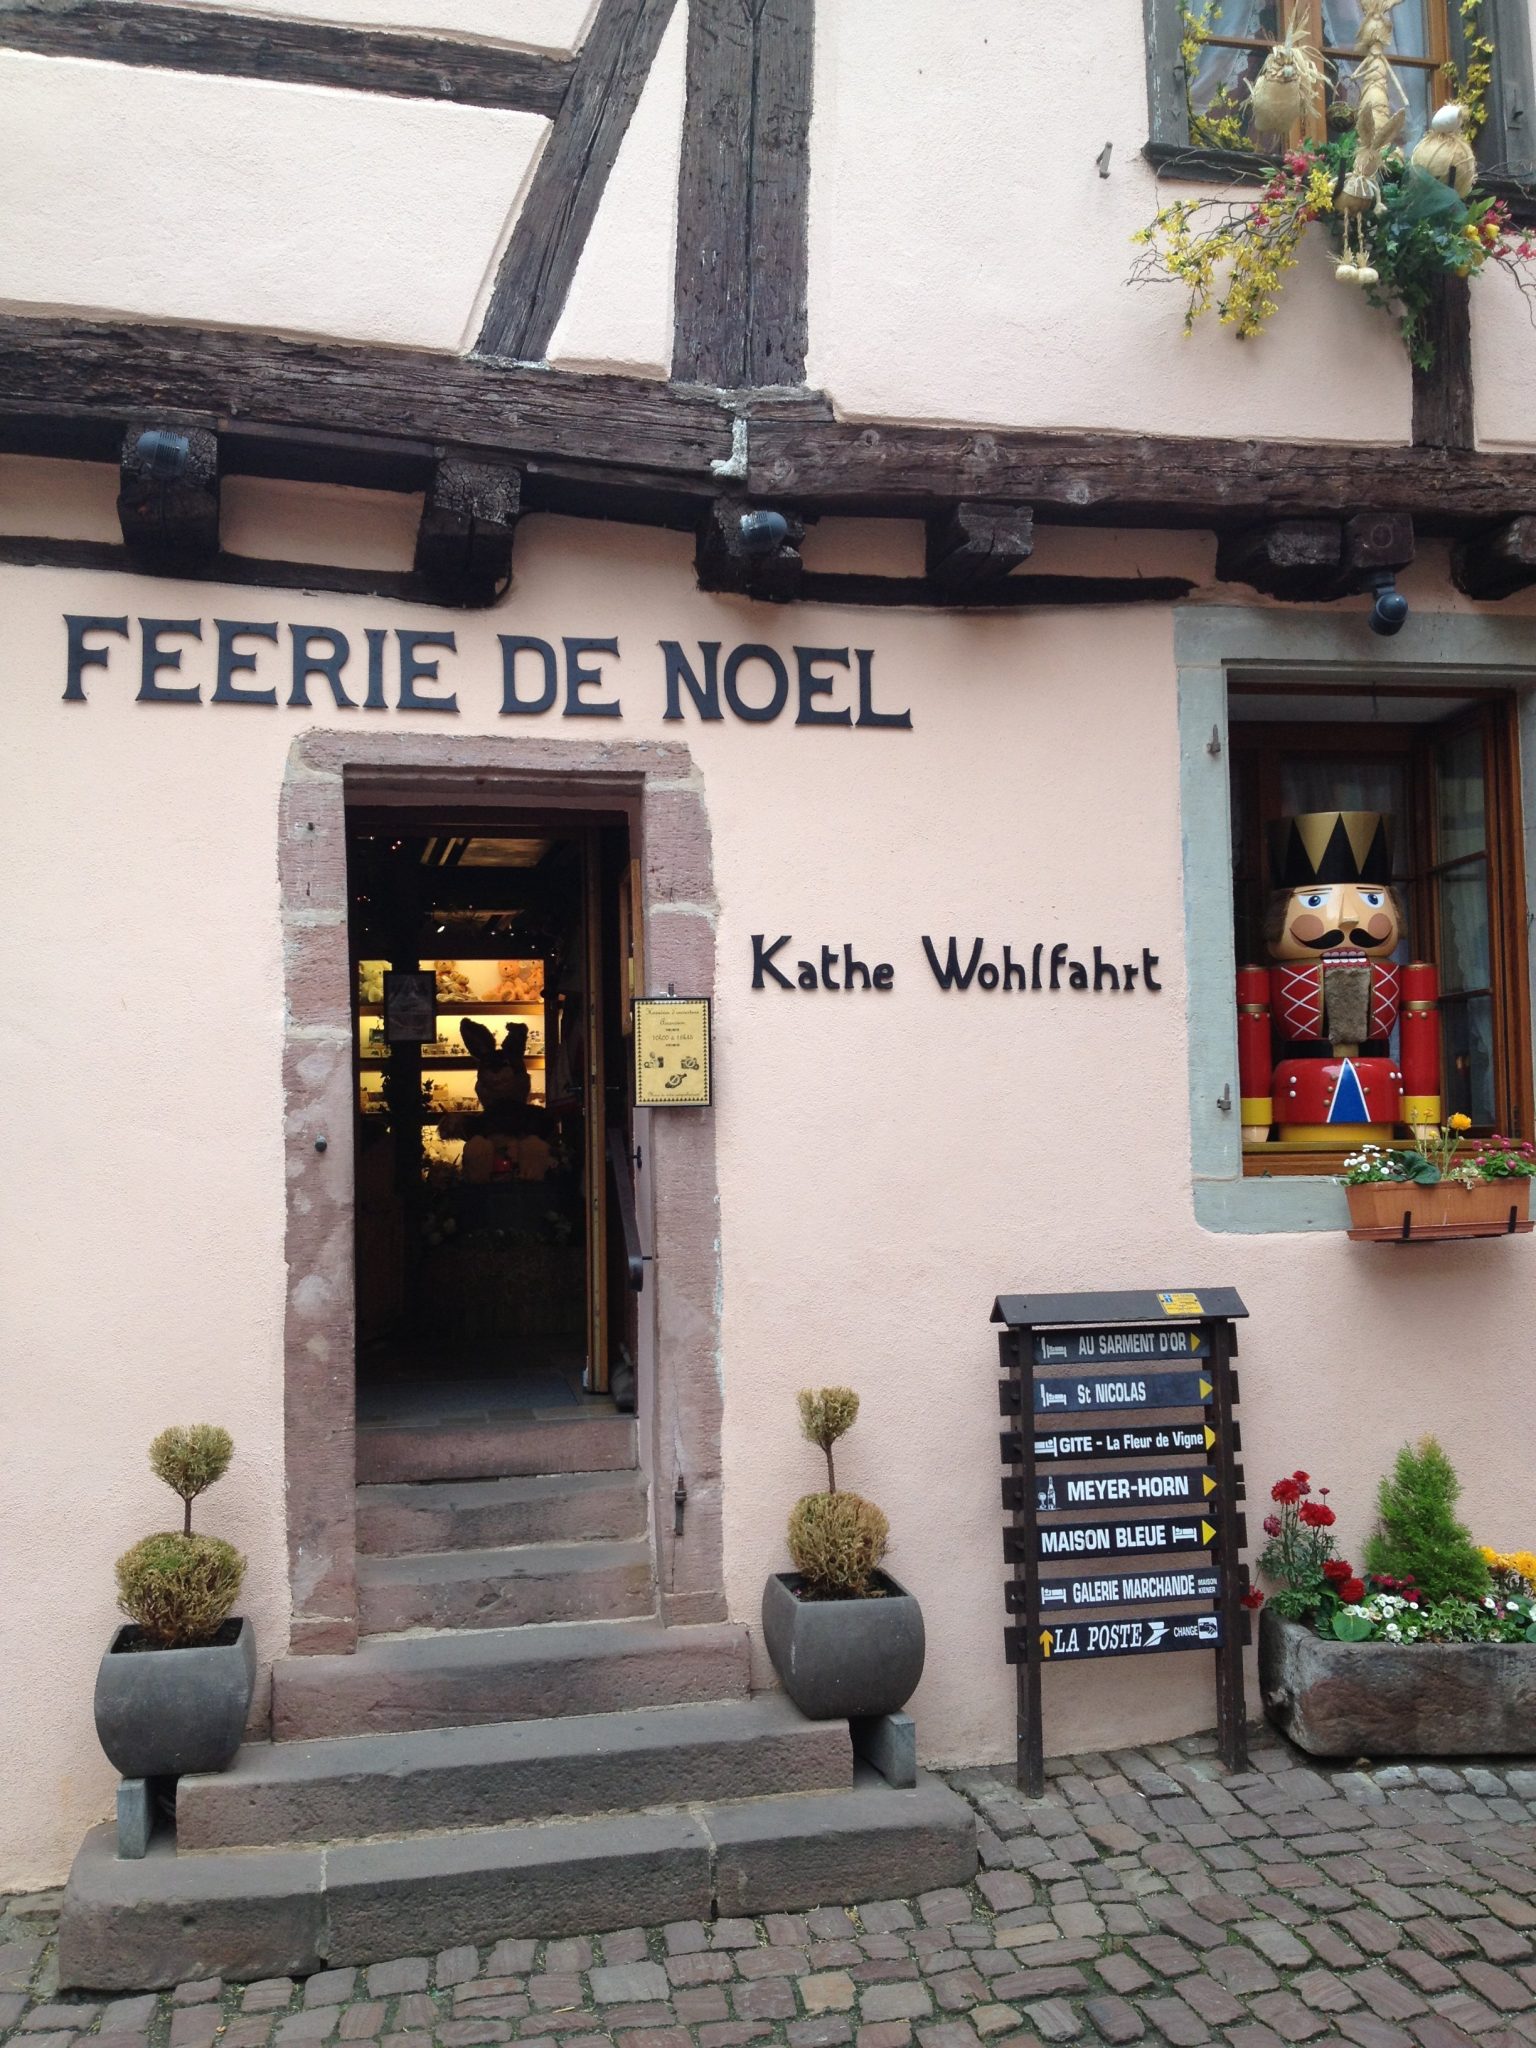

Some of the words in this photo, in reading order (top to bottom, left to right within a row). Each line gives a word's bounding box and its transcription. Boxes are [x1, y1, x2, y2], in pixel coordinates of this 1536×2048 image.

[61, 613, 461, 714] FEERIE
[496, 633, 624, 718] DE
[658, 639, 914, 729] NOEL
[750, 933, 895, 990] Kathe
[920, 935, 1162, 992] Wohlfahrt
[1078, 1335, 1095, 1356] AU
[1099, 1333, 1155, 1355] SARMENT
[1159, 1331, 1187, 1352] D'OR
[1077, 1384, 1091, 1404] St
[1095, 1381, 1146, 1403] NICOLAS
[1059, 1436, 1093, 1453] GITE
[1106, 1435, 1120, 1451] La
[1123, 1432, 1152, 1450] Fleur
[1156, 1433, 1169, 1448] de
[1172, 1431, 1203, 1450] Vigne
[1067, 1475, 1189, 1502] MEYER-HORN
[1041, 1528, 1110, 1553] MAISON
[1115, 1525, 1167, 1549] BLEUE
[1072, 1579, 1120, 1604] GALERIE
[1122, 1574, 1195, 1600] MARCHANDE
[1197, 1578, 1218, 1586] MAISON
[1053, 1628, 1080, 1653] LA
[1087, 1622, 1143, 1651] POSTE
[1173, 1625, 1199, 1638] CHANGE
